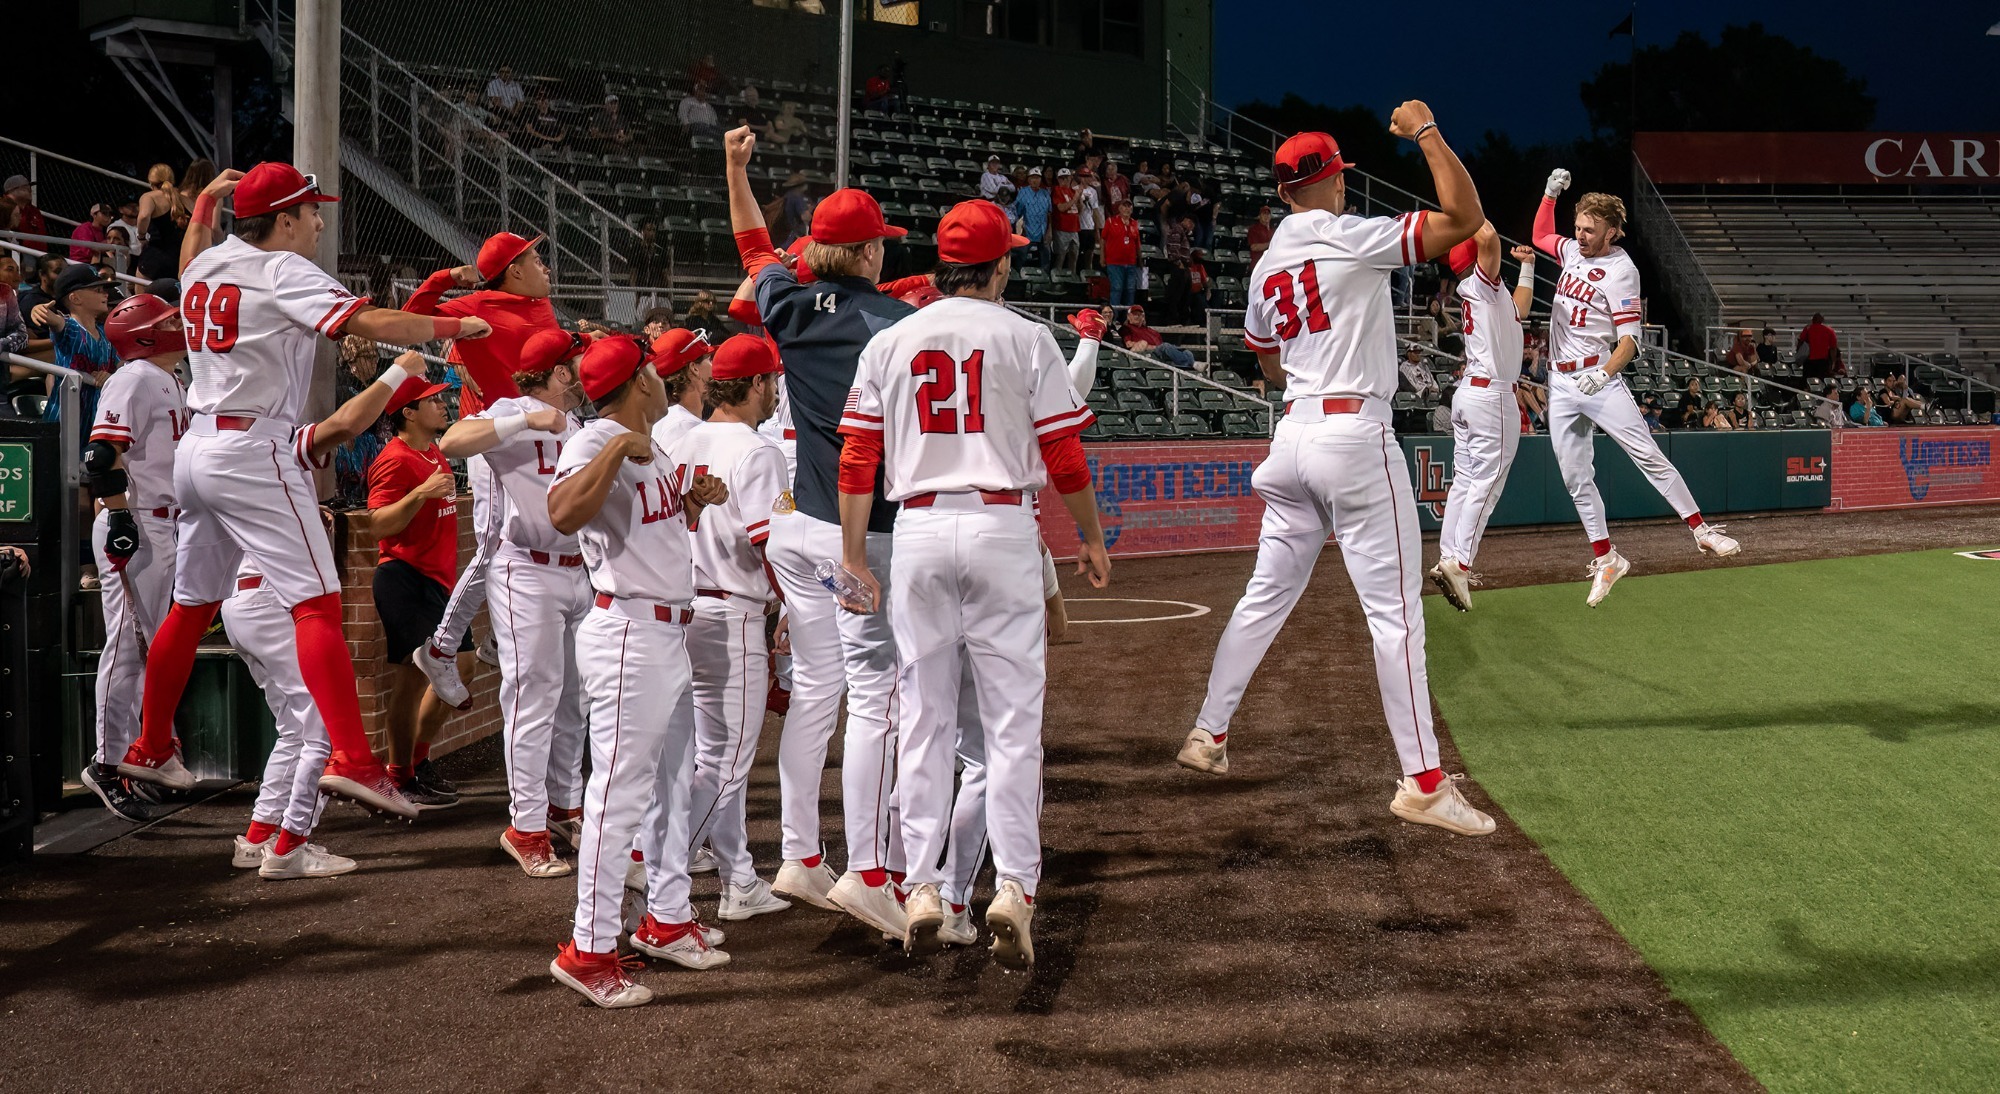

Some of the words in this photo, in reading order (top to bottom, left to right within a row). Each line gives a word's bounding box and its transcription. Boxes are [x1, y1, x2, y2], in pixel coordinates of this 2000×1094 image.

[814, 293, 836, 313] 14
[1263, 258, 1331, 342] 31
[183, 281, 241, 353] 99
[1569, 305, 1588, 328] 11
[911, 349, 985, 434] 21
[1786, 456, 1823, 475] SLC
[1786, 474, 1824, 483] SOUTHLAND
